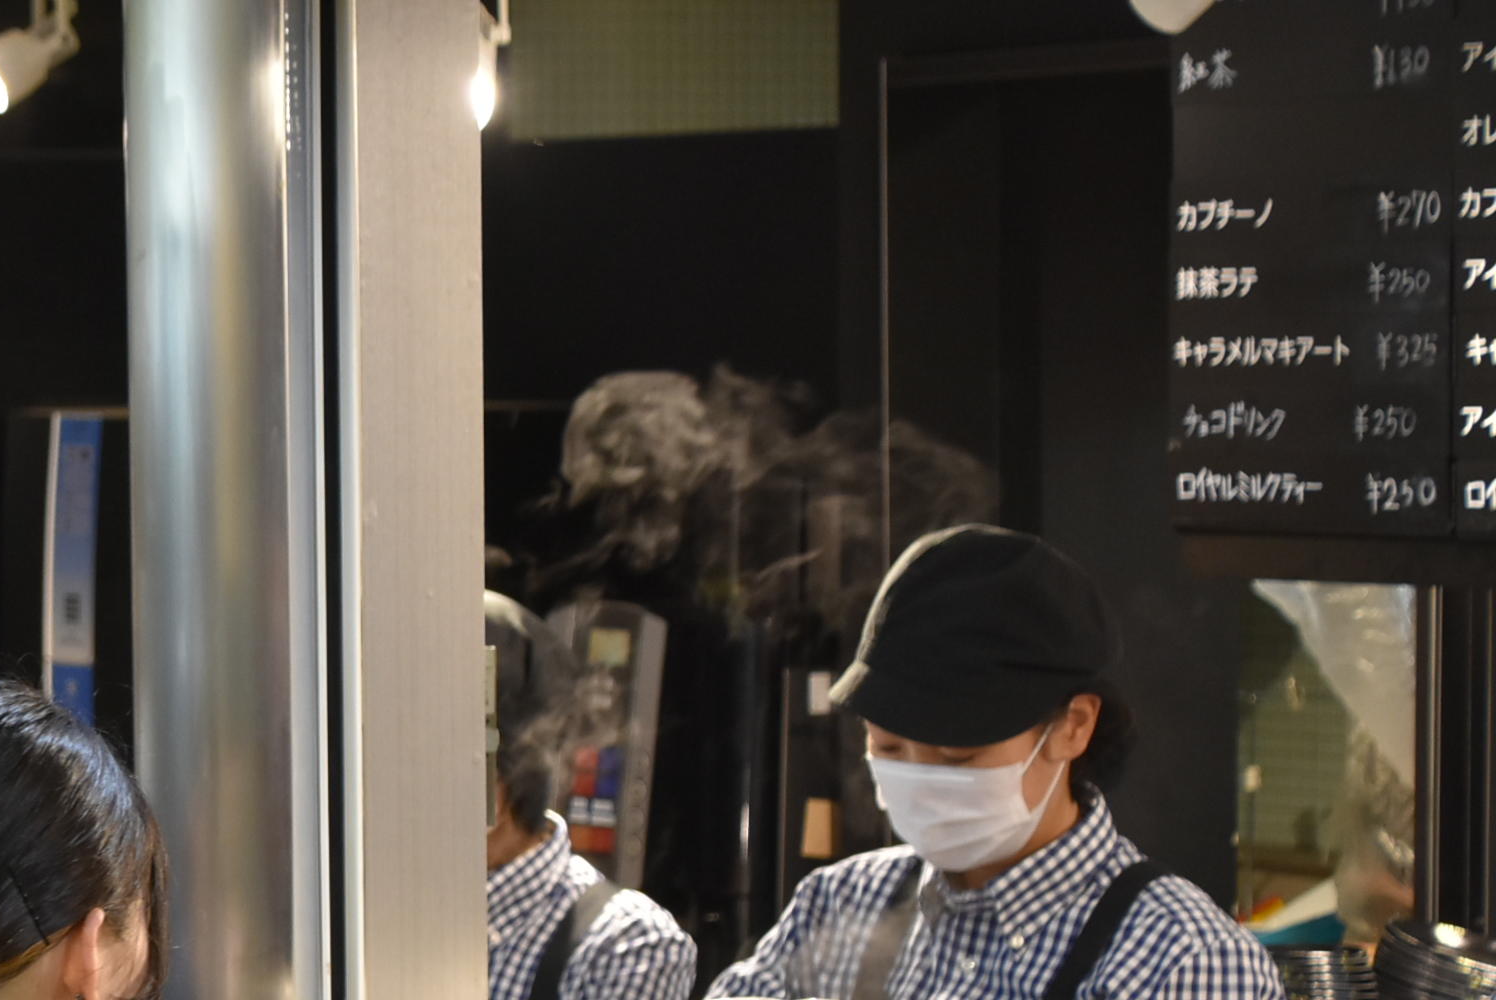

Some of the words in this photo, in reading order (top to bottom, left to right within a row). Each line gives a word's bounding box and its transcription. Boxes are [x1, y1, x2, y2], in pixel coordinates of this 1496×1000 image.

[1177, 198, 1273, 232] カプチーノ
[1378, 190, 1441, 234] ¥270
[1177, 266, 1258, 300] 抹茶ラテ
[1369, 261, 1430, 303] ¥250
[1173, 335, 1350, 368] キャラメルマキアート
[1183, 400, 1286, 440] チョコドリンク
[1354, 404, 1417, 443] ¥250
[1176, 467, 1323, 504] ロイヤルミルクティー
[1367, 471, 1436, 515] ¥250
